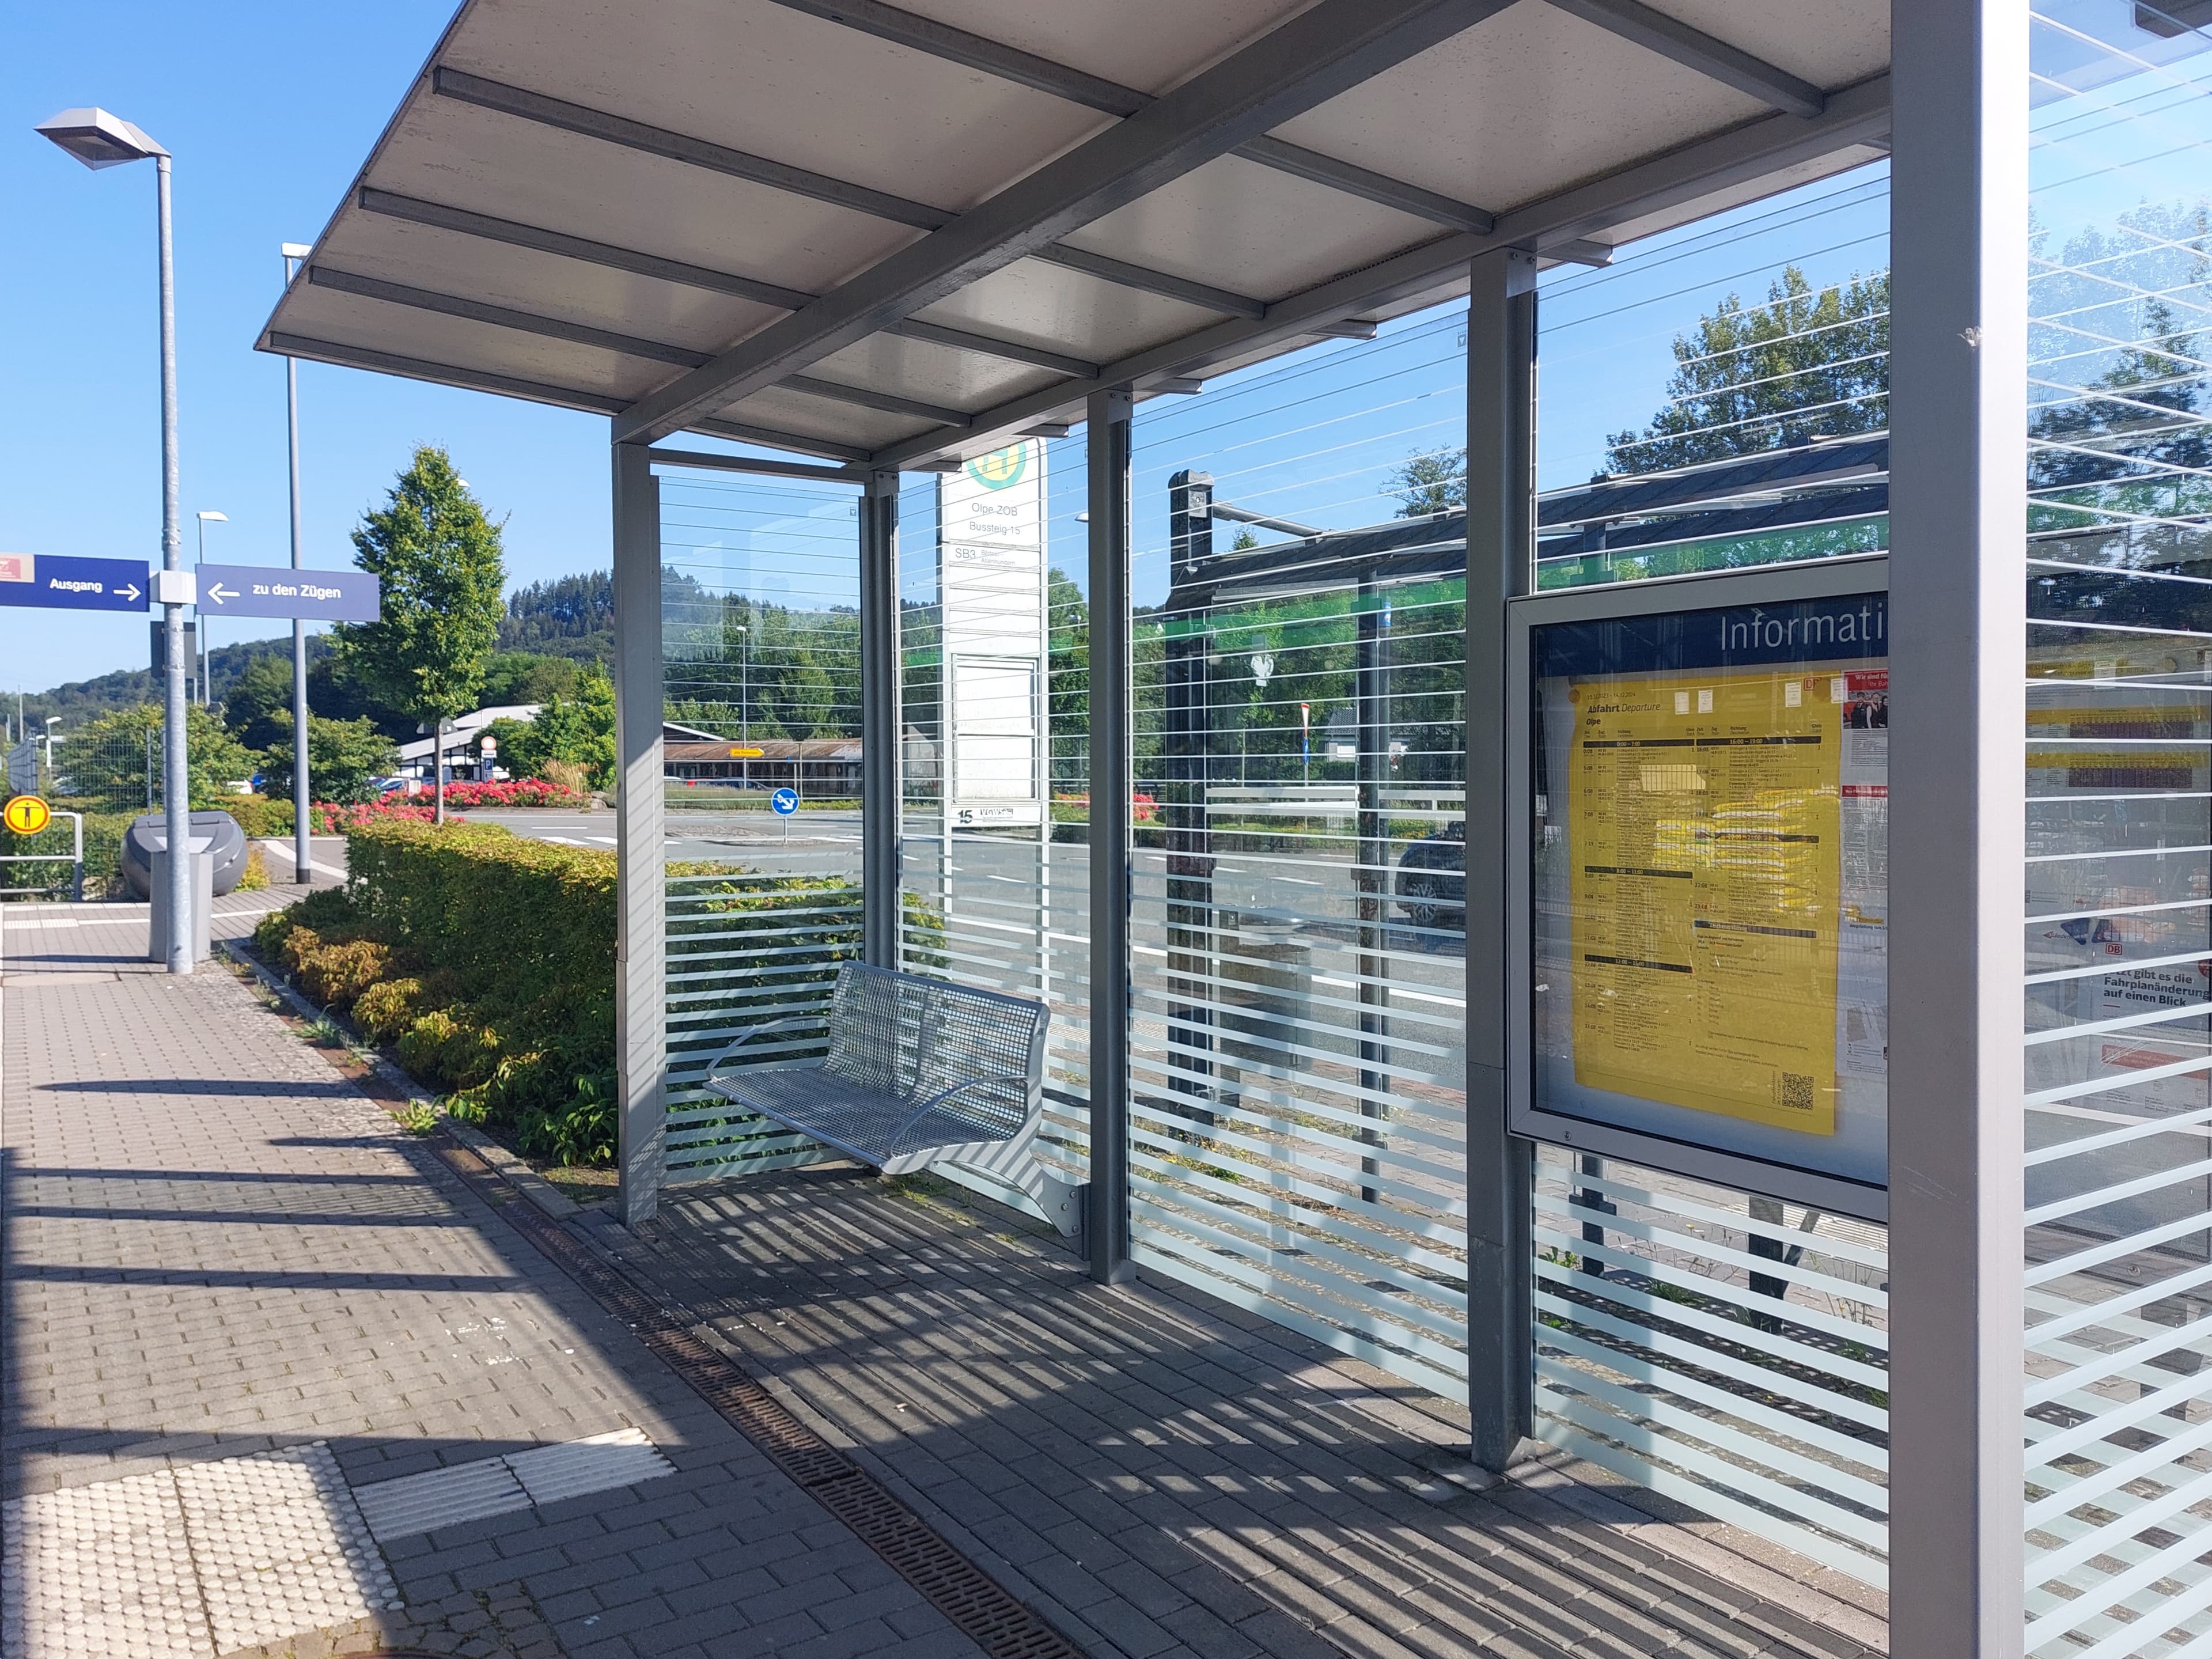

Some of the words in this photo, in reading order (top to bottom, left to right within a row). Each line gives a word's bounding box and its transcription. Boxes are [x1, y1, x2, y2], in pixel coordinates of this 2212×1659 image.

[972, 502, 994, 516] Olpe
[996, 505, 1018, 516] ZOB
[969, 521, 1007, 536] Bussteig
[1010, 526, 1021, 535] 15
[955, 548, 976, 559] SB3
[50, 578, 103, 593] Ausgang
[252, 584, 269, 596] zu
[272, 583, 298, 596] den
[300, 584, 342, 600] Zügen
[1721, 602, 1883, 650] Informati
[1588, 704, 1620, 714] Abfahrt
[1622, 703, 1661, 714] Departure
[1586, 718, 1601, 727] Olpe
[958, 809, 974, 824] 15
[2107, 944, 2121, 953] DB
[2134, 969, 2157, 980] gibt
[2158, 973, 2171, 981] es
[2173, 974, 2193, 984] die
[2104, 989, 2123, 999] auf
[2125, 991, 2156, 1003] einen
[2158, 994, 2187, 1007] Blick
